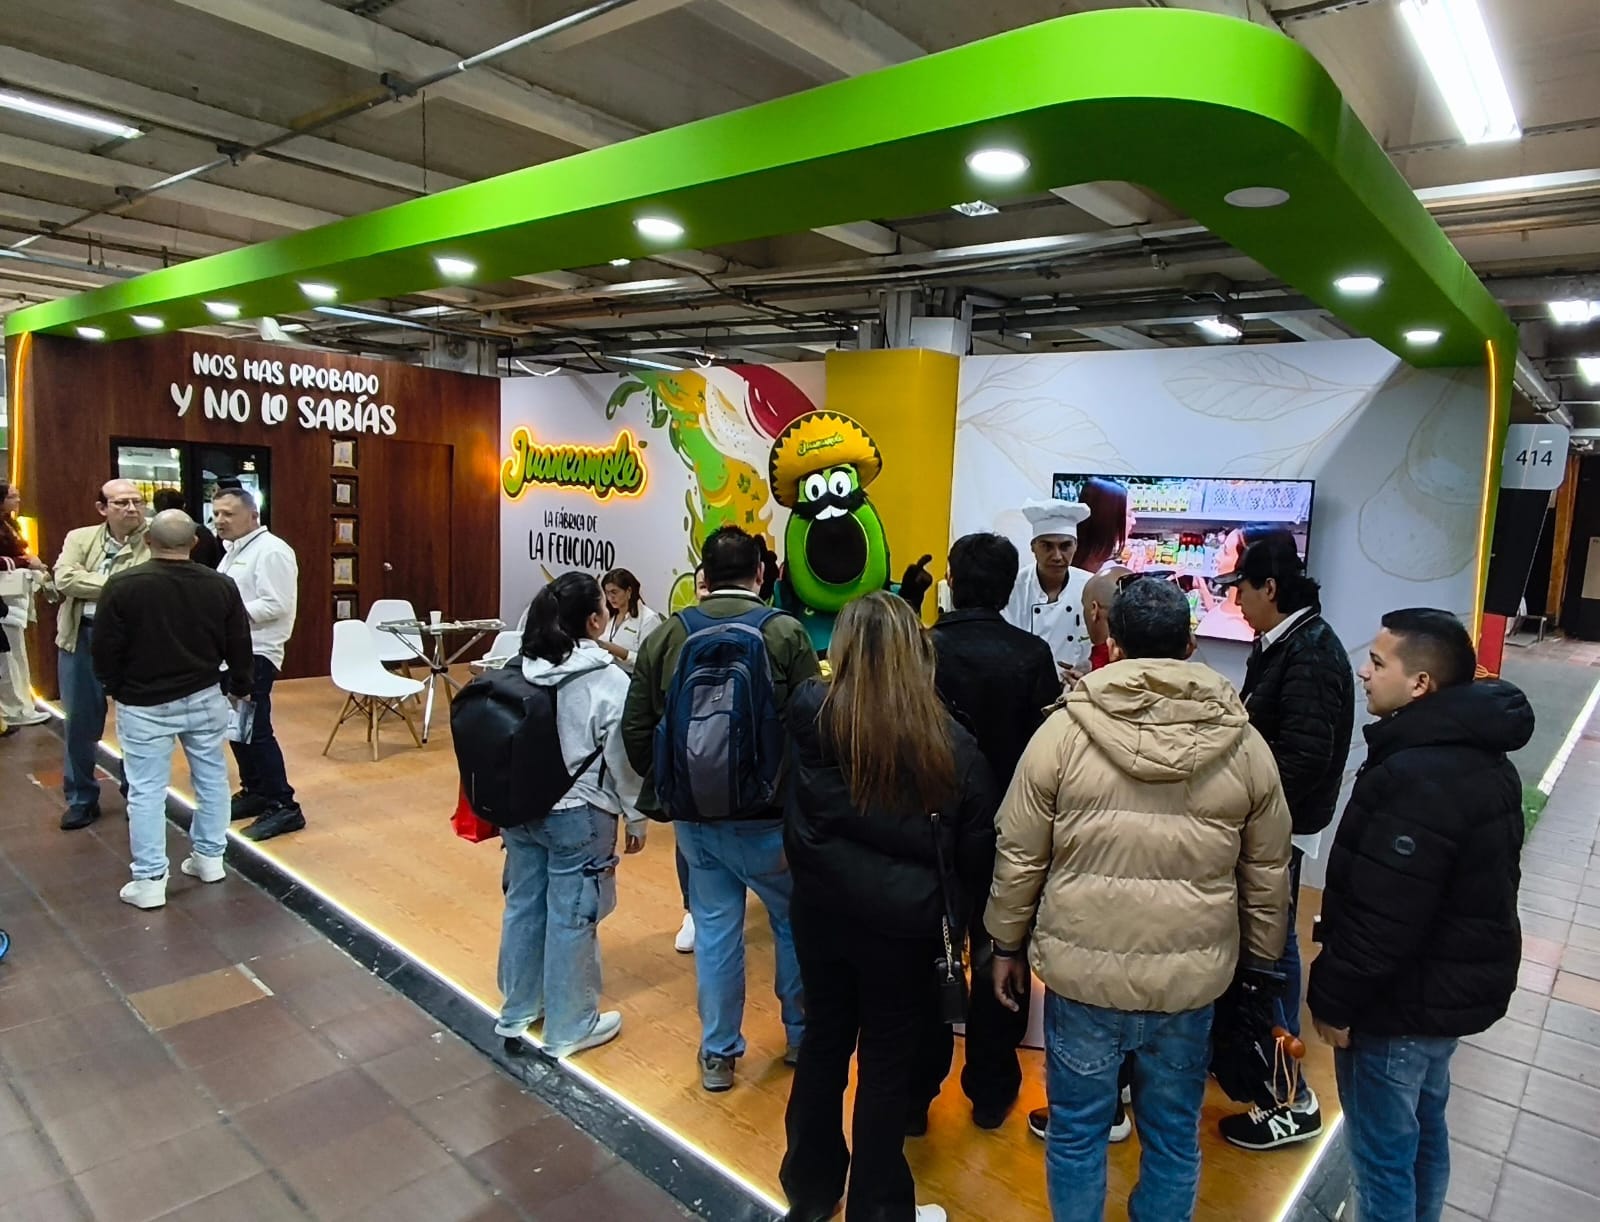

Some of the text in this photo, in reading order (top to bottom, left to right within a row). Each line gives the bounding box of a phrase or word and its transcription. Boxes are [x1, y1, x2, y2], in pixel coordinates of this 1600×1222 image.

[193, 351, 379, 395] NOS HAS PROBADO
[170, 382, 397, 435] Y NO LO SABÍAS
[502, 427, 645, 499] Juancamole
[1515, 450, 1553, 466] 414
[544, 506, 598, 533] LA FÁBRICA DE
[528, 529, 616, 572] LA FELICIDAD
